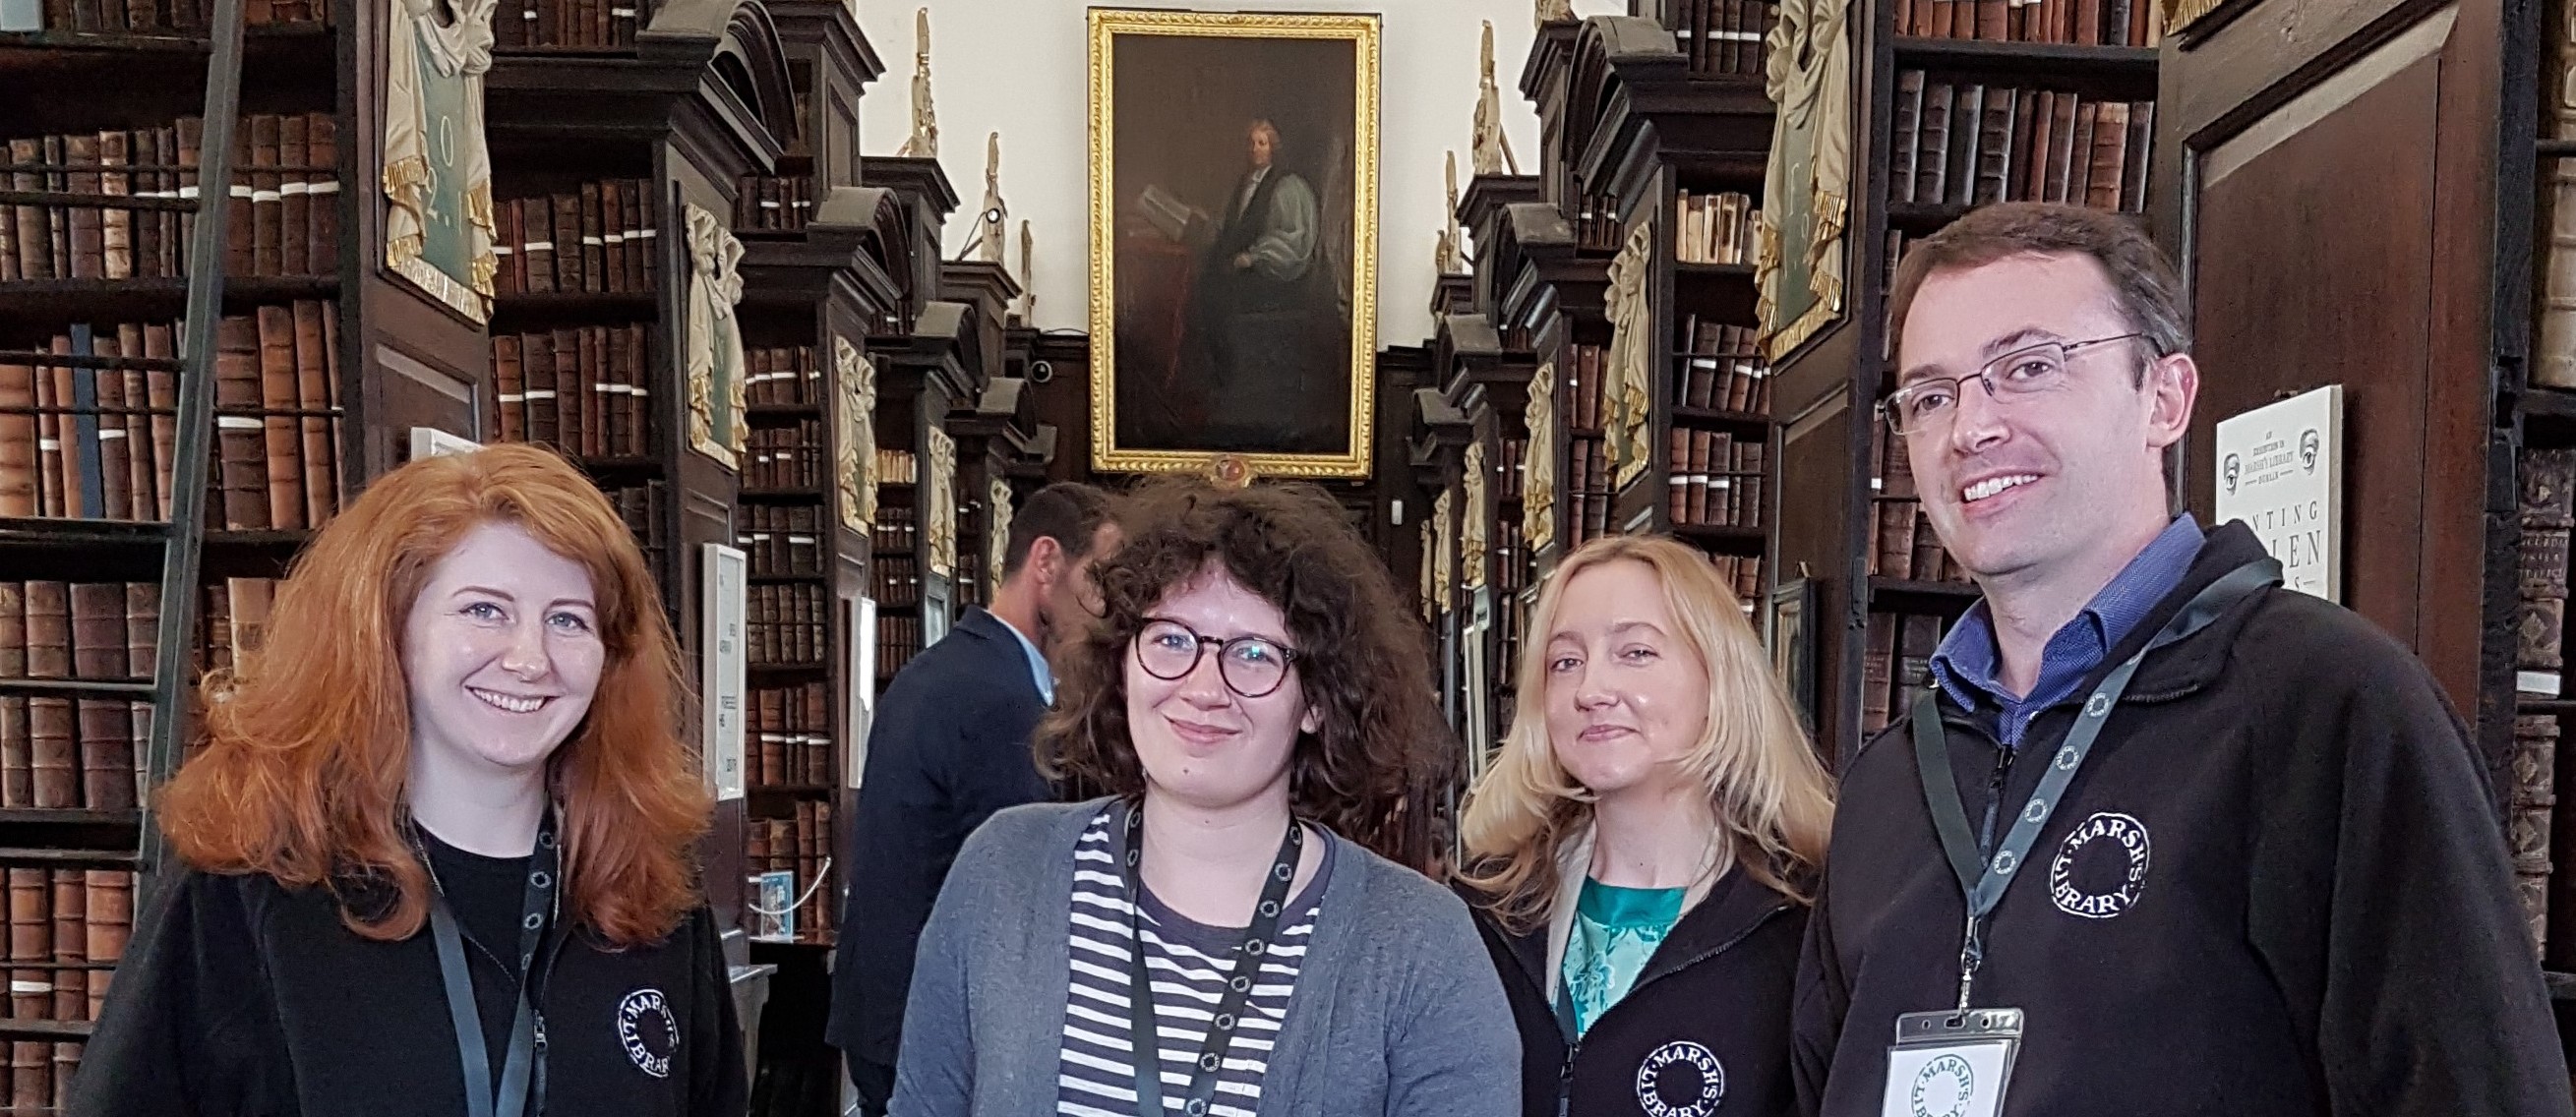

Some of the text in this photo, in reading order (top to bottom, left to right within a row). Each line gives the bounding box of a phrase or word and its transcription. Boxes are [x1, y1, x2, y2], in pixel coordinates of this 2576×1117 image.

[2251, 500, 2317, 532] NTING
[2055, 854, 2131, 913] LIBRARY
[1922, 1058, 1970, 1101] MARSH'S
